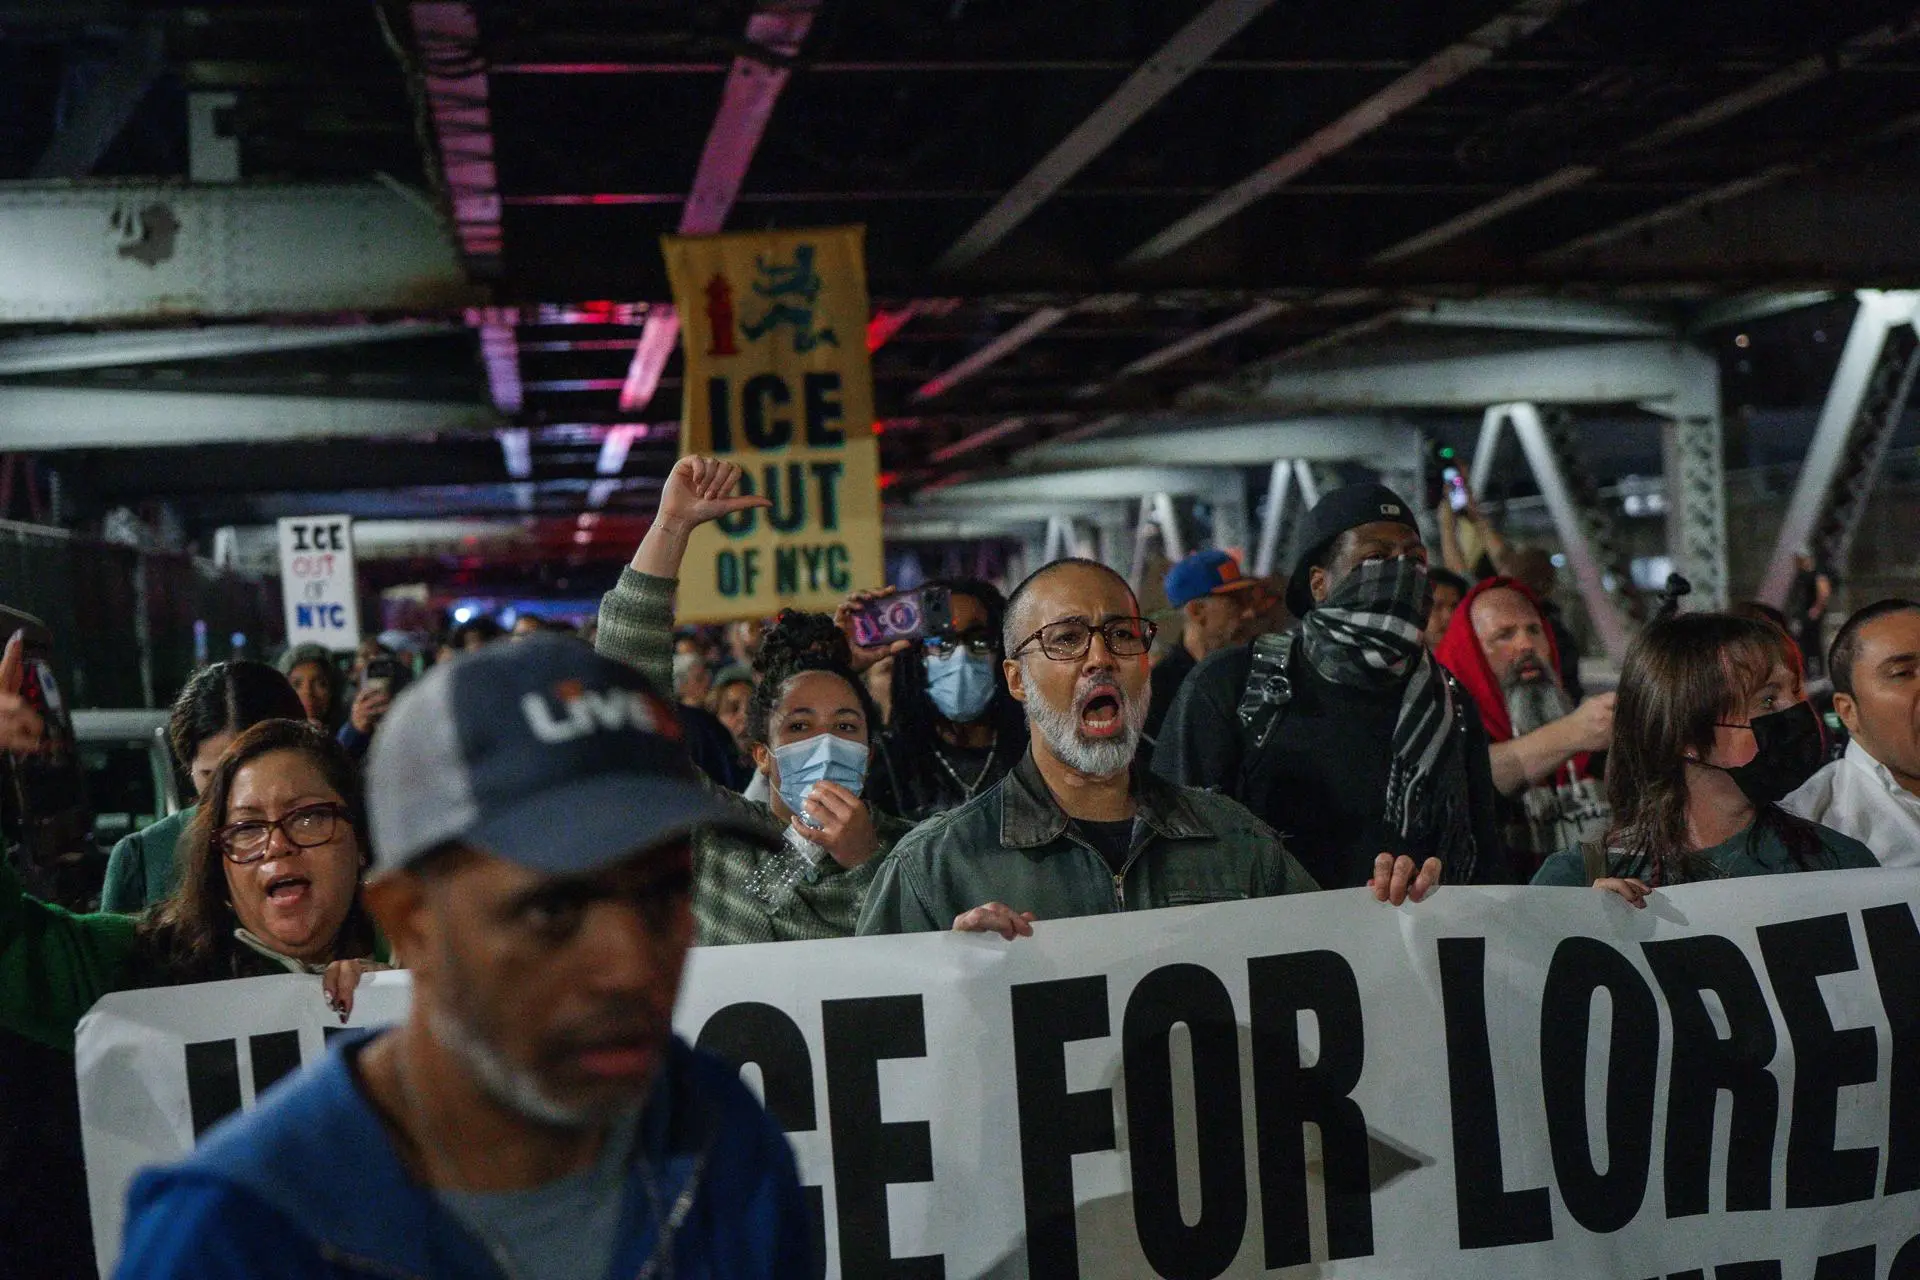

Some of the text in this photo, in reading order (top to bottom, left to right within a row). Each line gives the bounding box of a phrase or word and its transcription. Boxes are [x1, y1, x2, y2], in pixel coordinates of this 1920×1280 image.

[709, 373, 844, 452] ICE
[292, 525, 343, 550] ICE
[292, 553, 335, 577] OUT
[717, 547, 850, 596] OF NYC
[297, 604, 344, 628] NYC
[1010, 949, 1375, 1280] FOR
